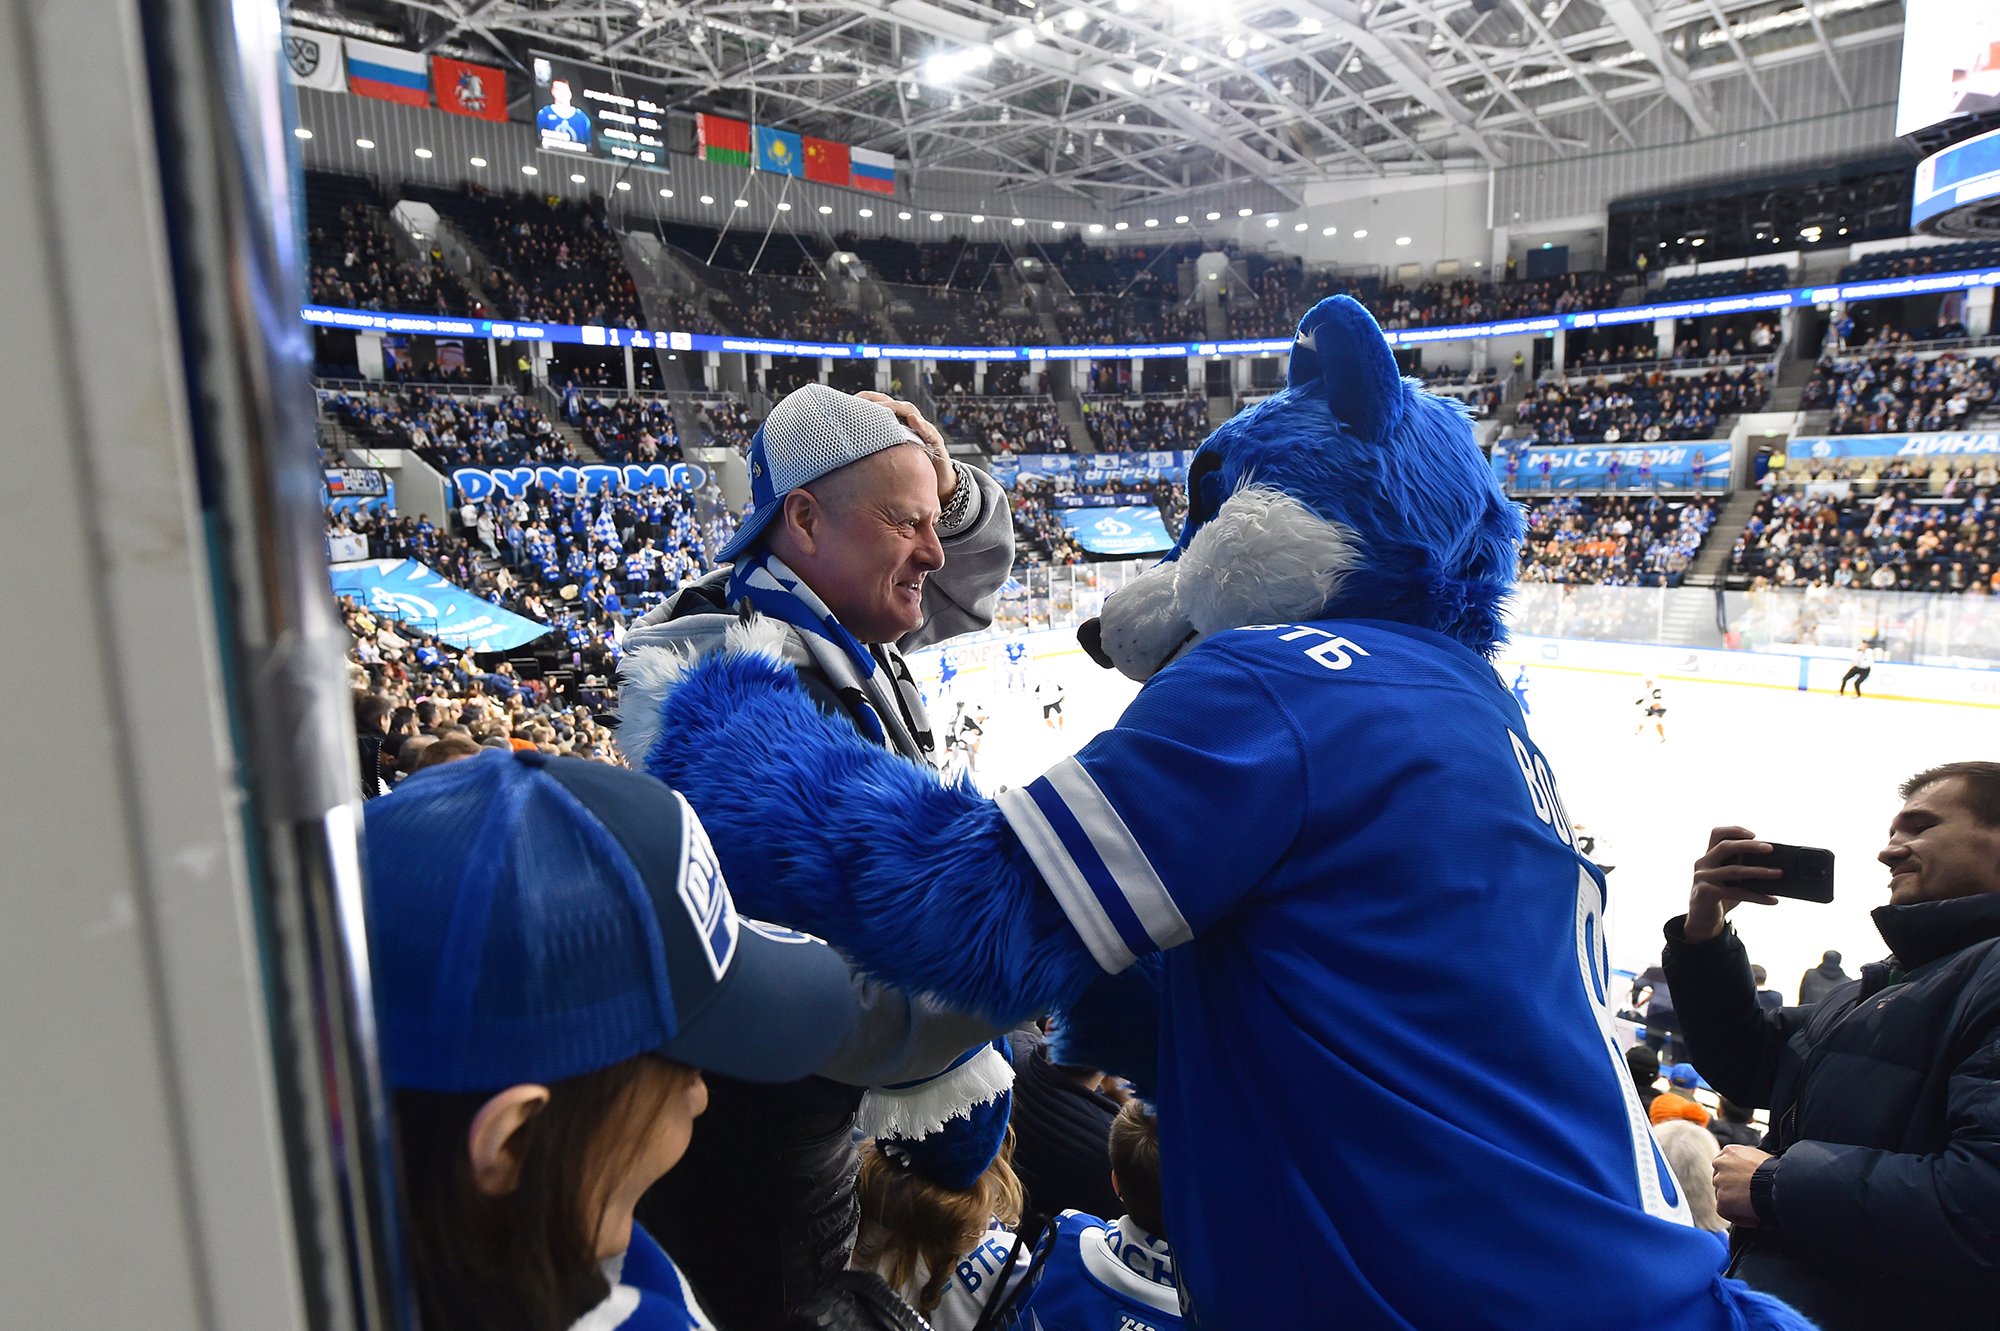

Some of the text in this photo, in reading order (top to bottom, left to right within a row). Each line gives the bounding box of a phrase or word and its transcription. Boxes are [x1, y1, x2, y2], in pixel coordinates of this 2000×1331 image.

[609, 328, 620, 346] 1
[655, 331, 667, 349] 2
[1527, 452, 1571, 468] МЫ
[1594, 446, 1687, 467] ТОБОЙ!
[453, 464, 706, 503] DYNAMO
[955, 1237, 1010, 1294] ВТБ
